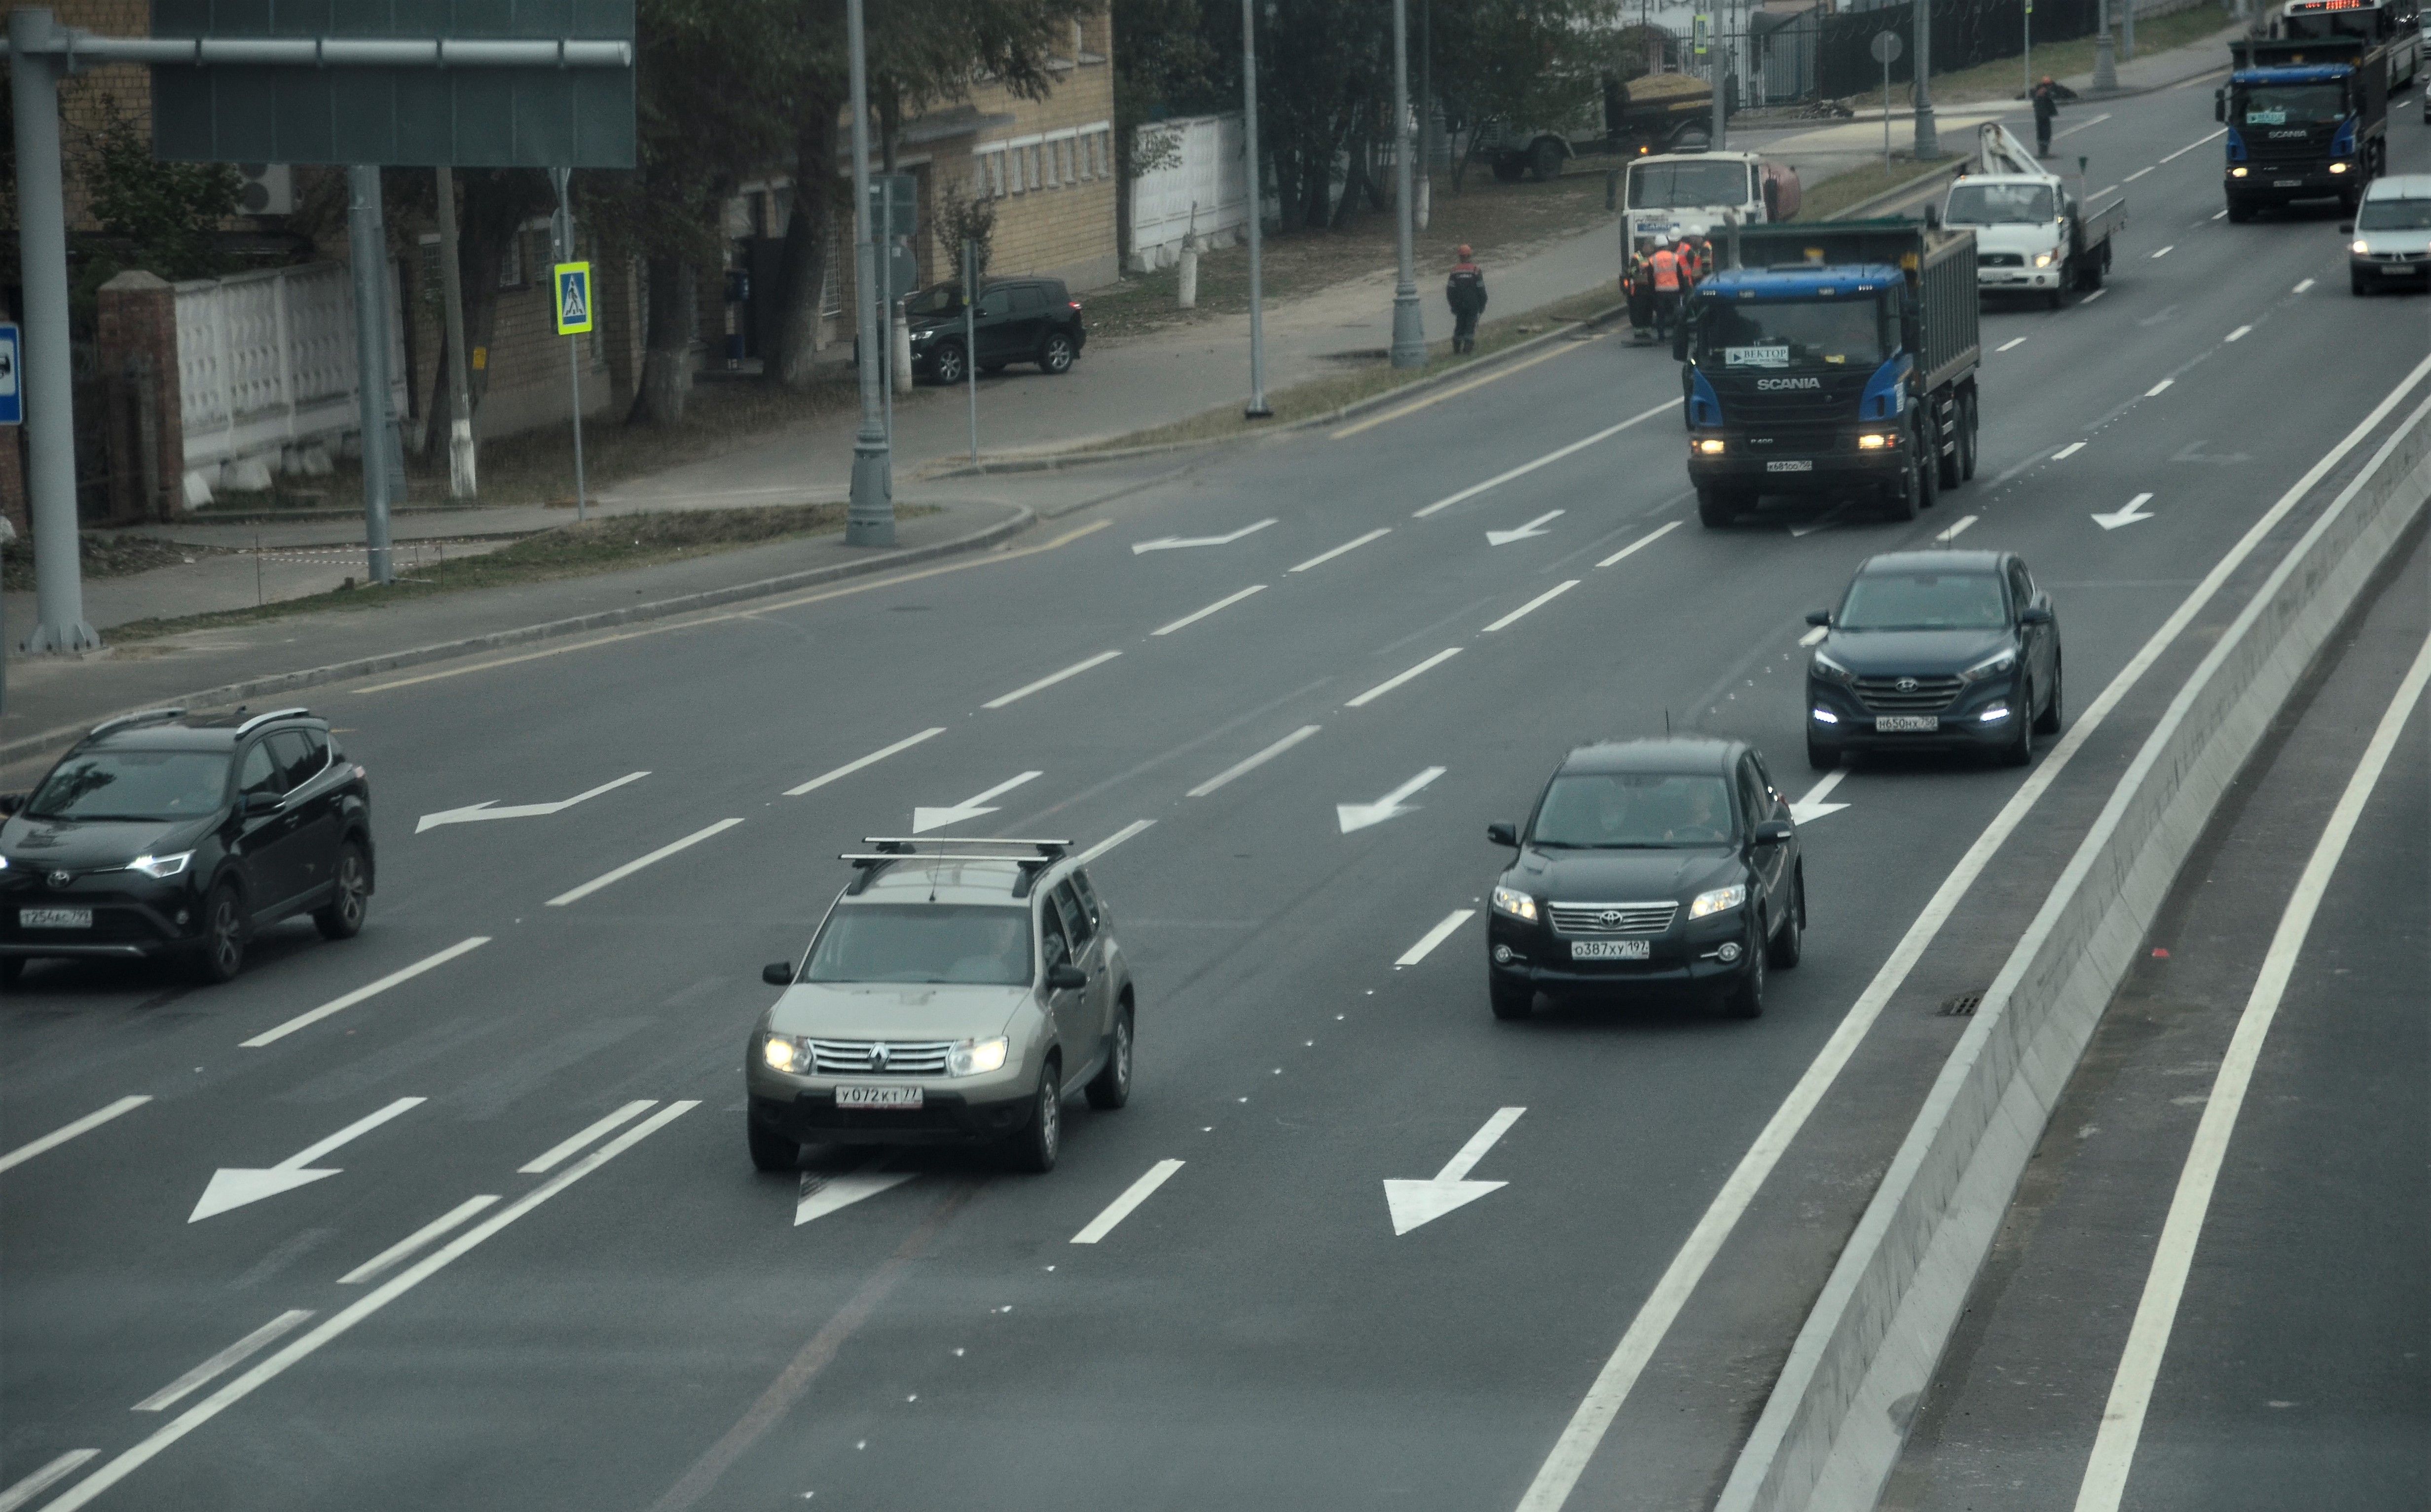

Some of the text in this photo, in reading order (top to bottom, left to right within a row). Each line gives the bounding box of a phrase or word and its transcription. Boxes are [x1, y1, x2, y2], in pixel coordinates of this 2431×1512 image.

[2268, 130, 2307, 139] SCANIA
[1744, 349, 1786, 359] ВЕКТОР
[1757, 378, 1821, 390] SCANIA
